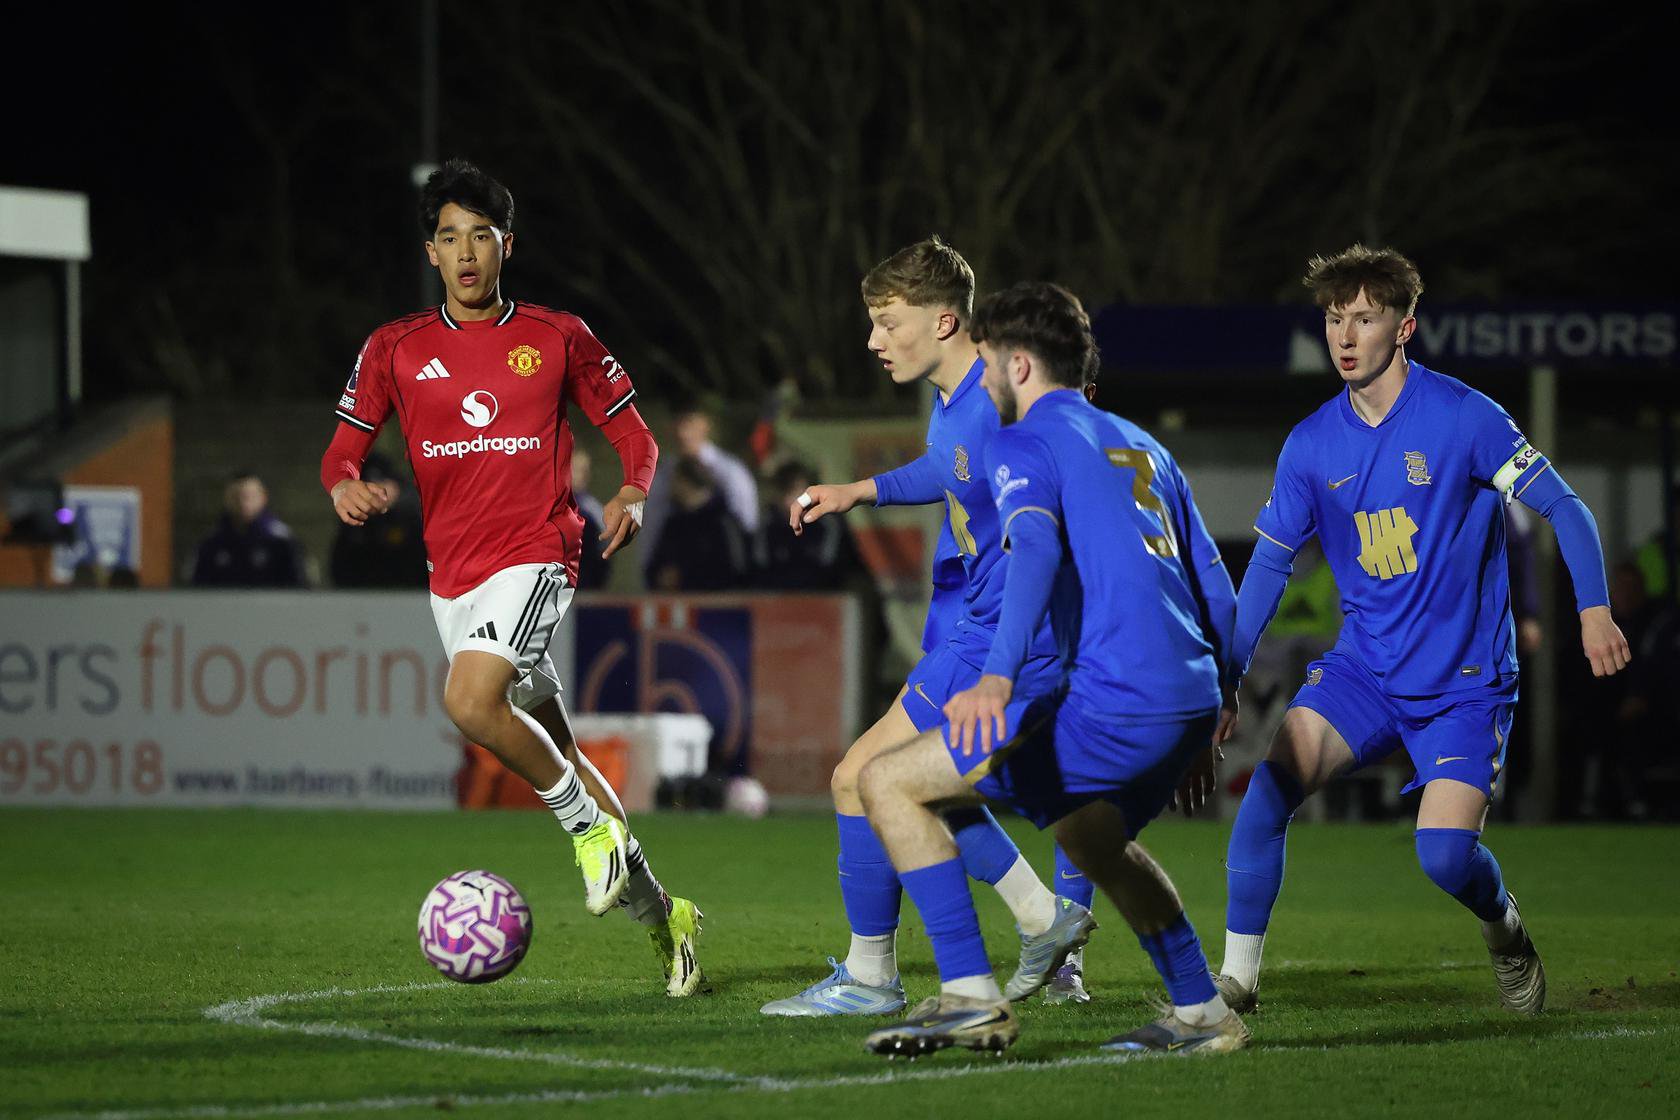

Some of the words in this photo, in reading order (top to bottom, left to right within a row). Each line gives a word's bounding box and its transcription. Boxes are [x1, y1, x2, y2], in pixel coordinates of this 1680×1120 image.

[1417, 313, 1676, 357] VISITORS
[422, 434, 541, 459] Snapdragon
[1103, 447, 1178, 558] 3
[0, 640, 119, 717] ers
[135, 617, 456, 722] floorin
[0, 737, 166, 796] 95018
